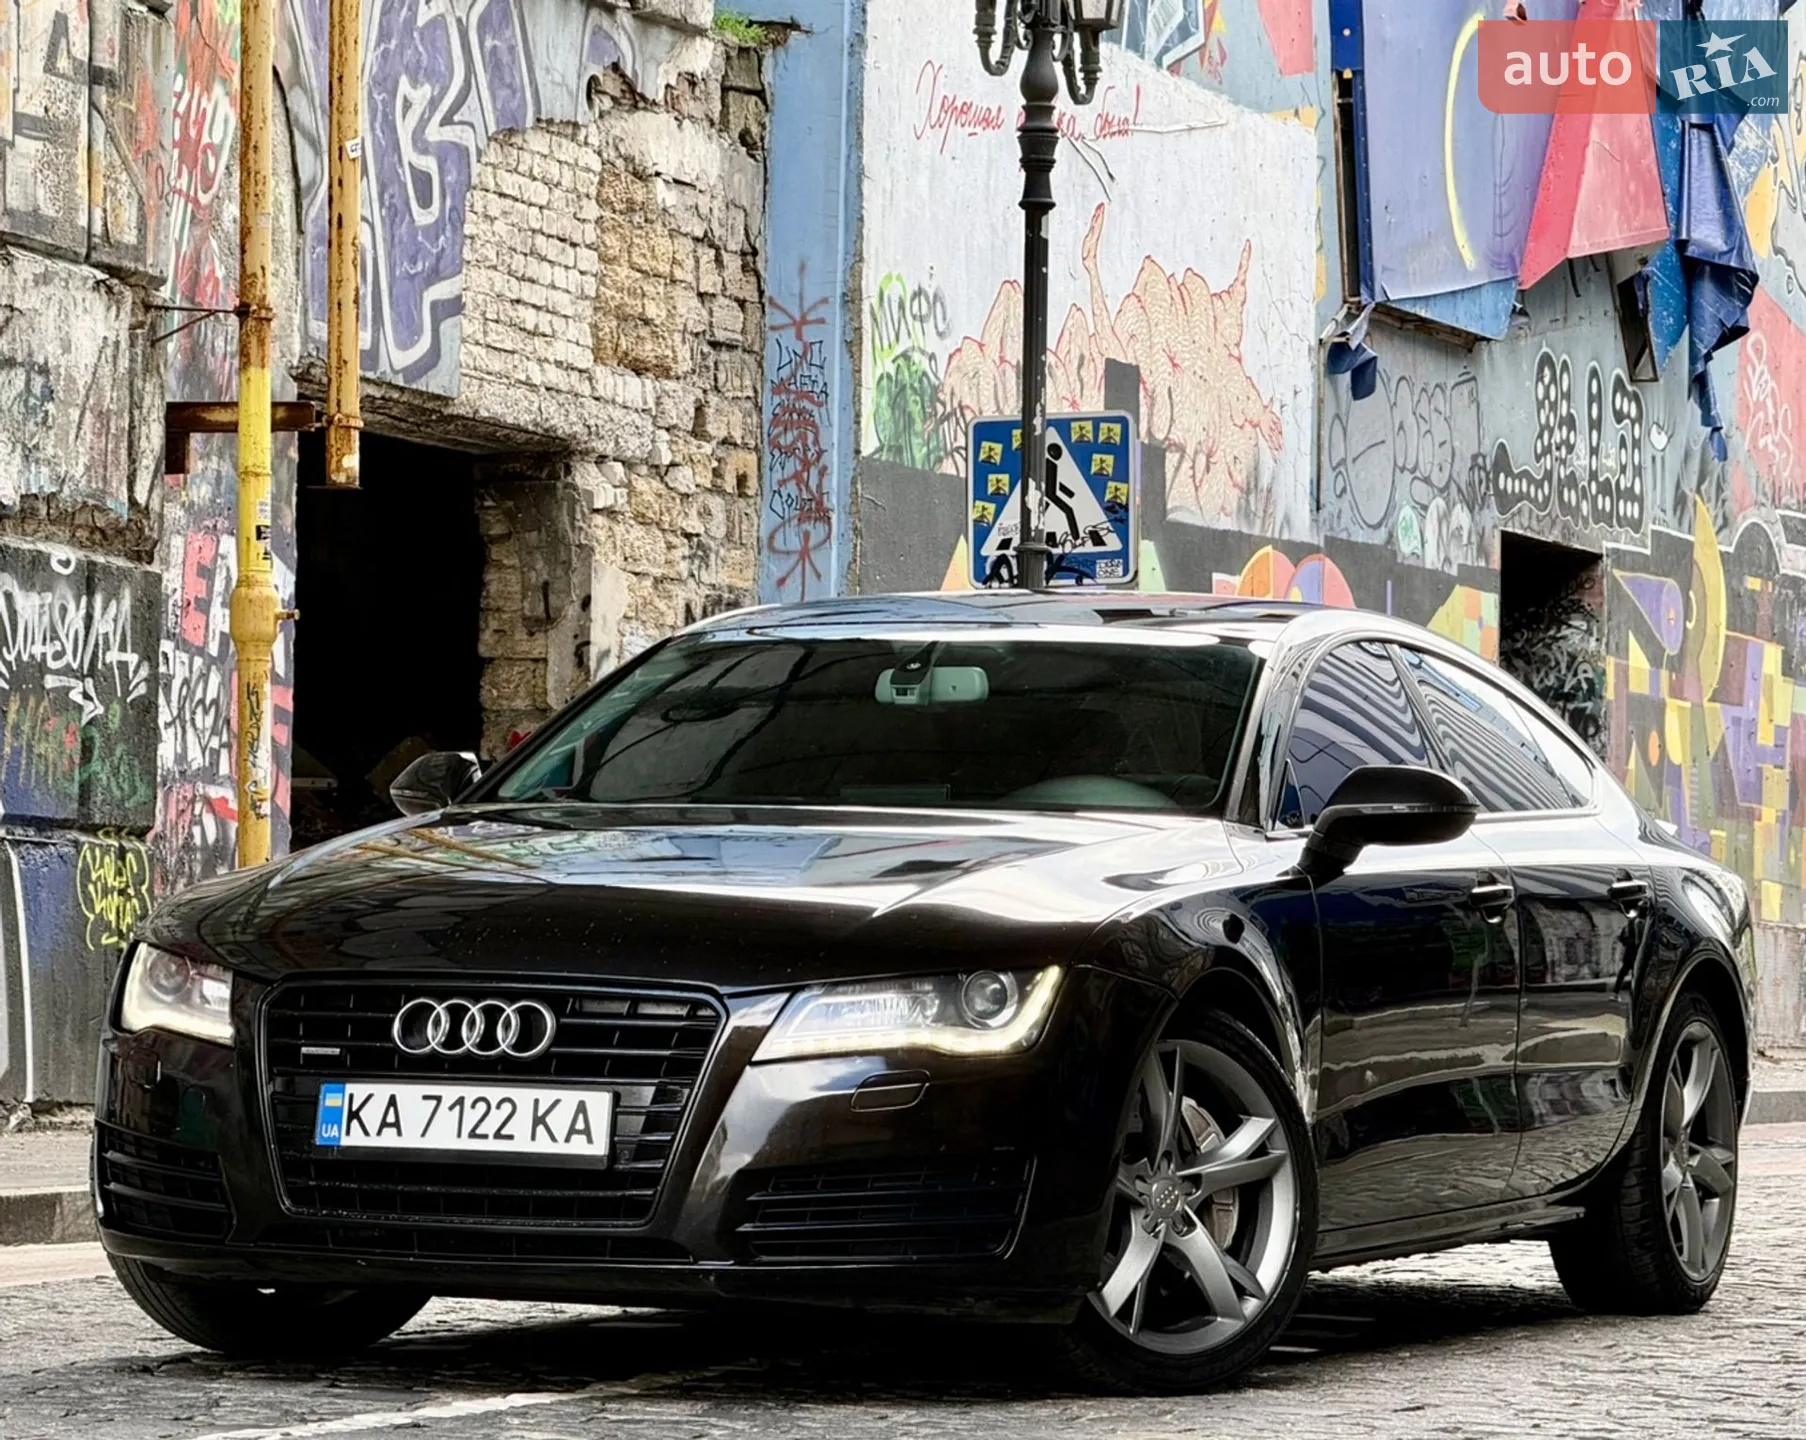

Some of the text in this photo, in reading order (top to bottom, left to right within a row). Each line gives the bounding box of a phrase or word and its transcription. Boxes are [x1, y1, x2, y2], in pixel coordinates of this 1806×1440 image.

[321, 1123, 339, 1138] UA
[345, 1092, 594, 1145] KA 7122 KA
